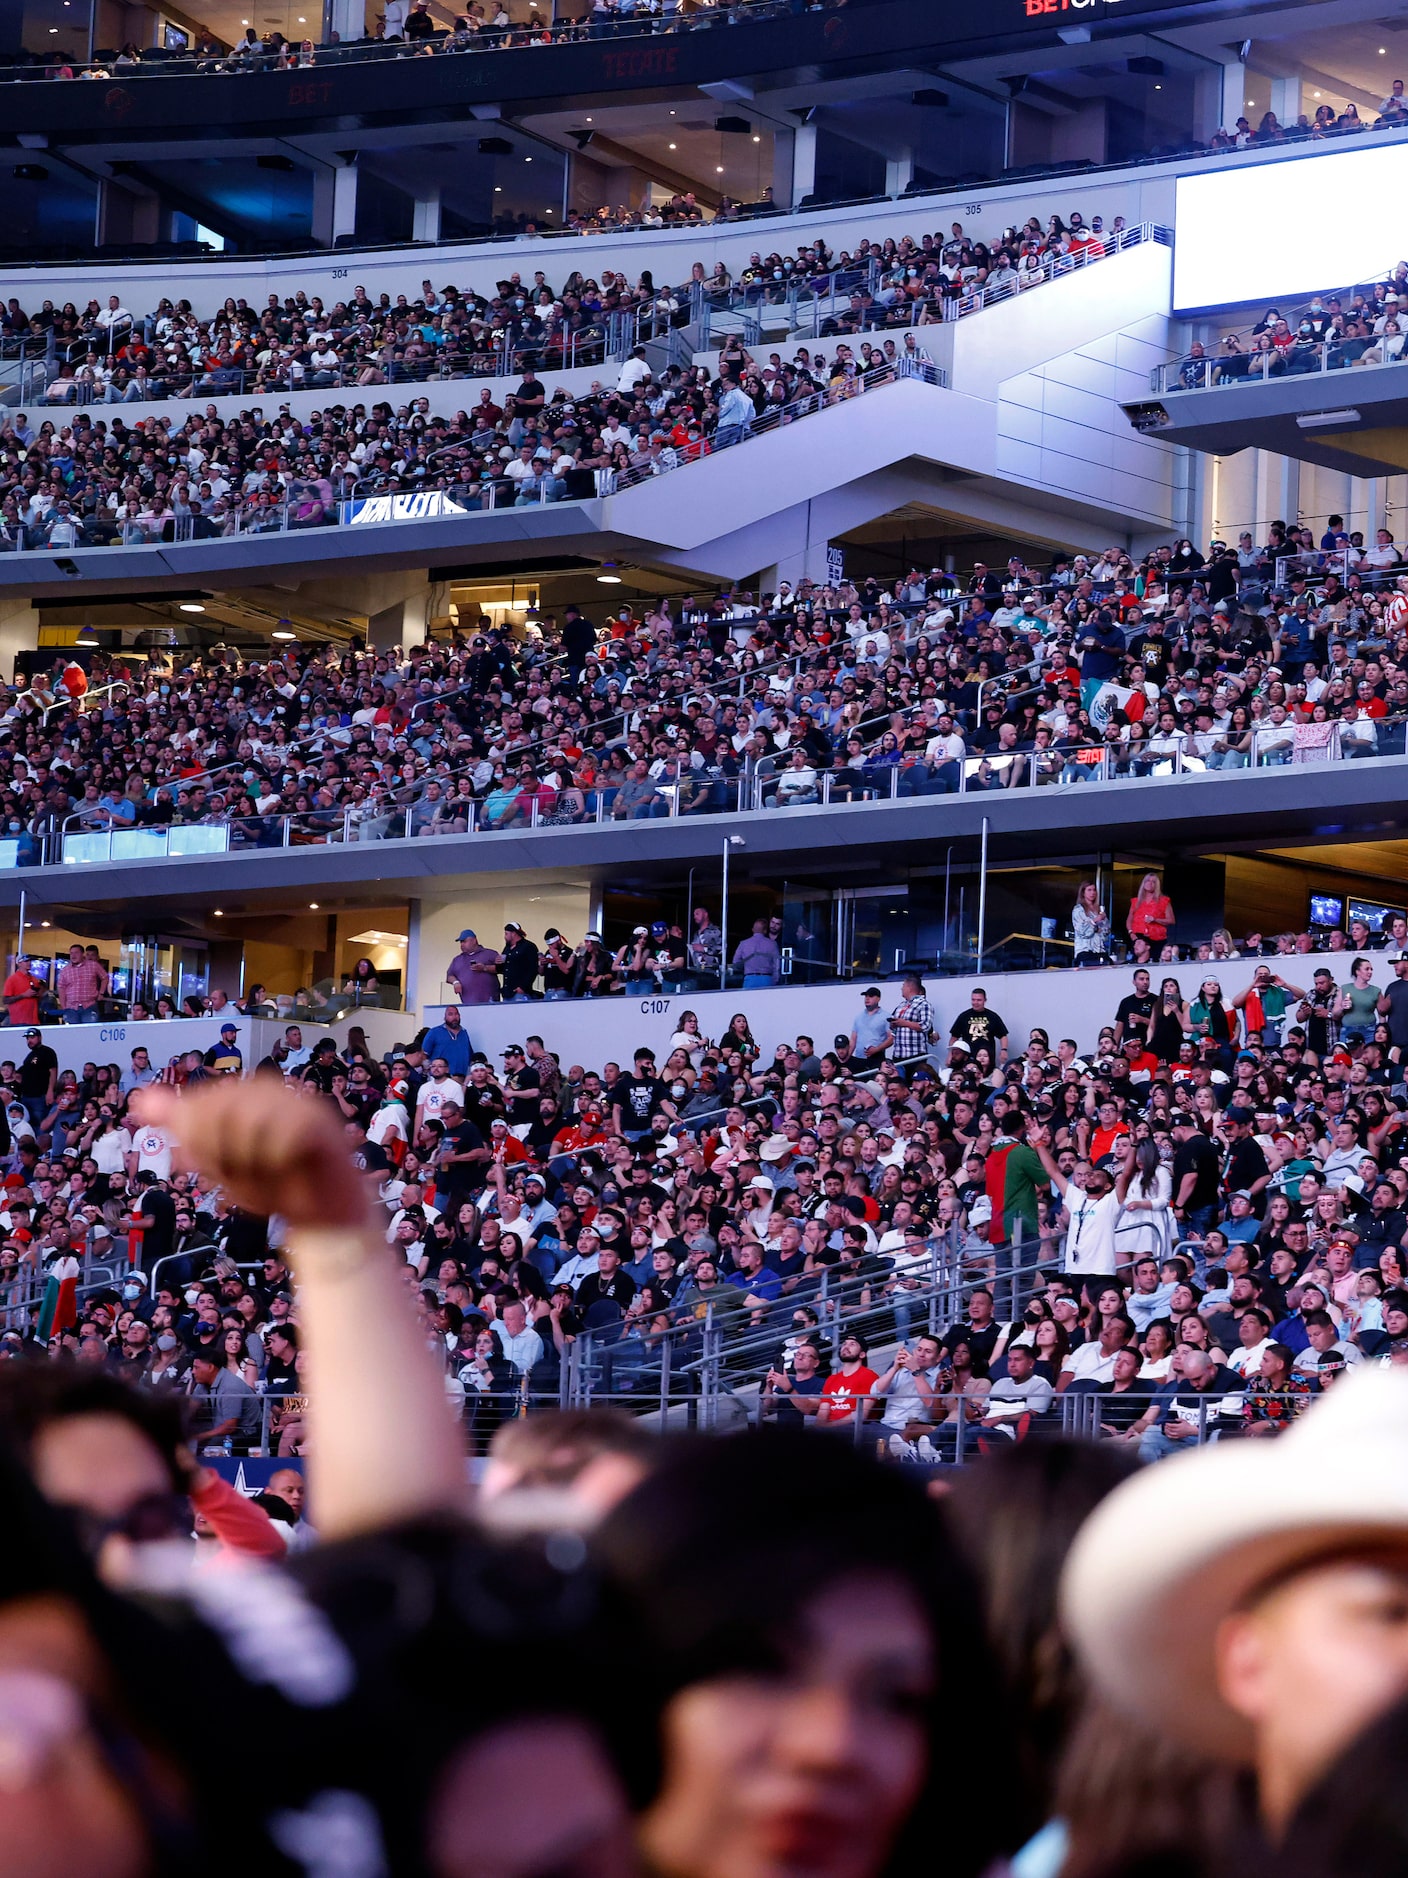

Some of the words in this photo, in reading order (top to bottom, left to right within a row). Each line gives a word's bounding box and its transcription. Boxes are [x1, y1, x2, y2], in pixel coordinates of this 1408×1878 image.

[965, 205, 982, 216] 305
[332, 269, 348, 279] 304
[828, 547, 843, 566] 205
[641, 1000, 670, 1013] C107
[100, 1029, 126, 1041] C106
